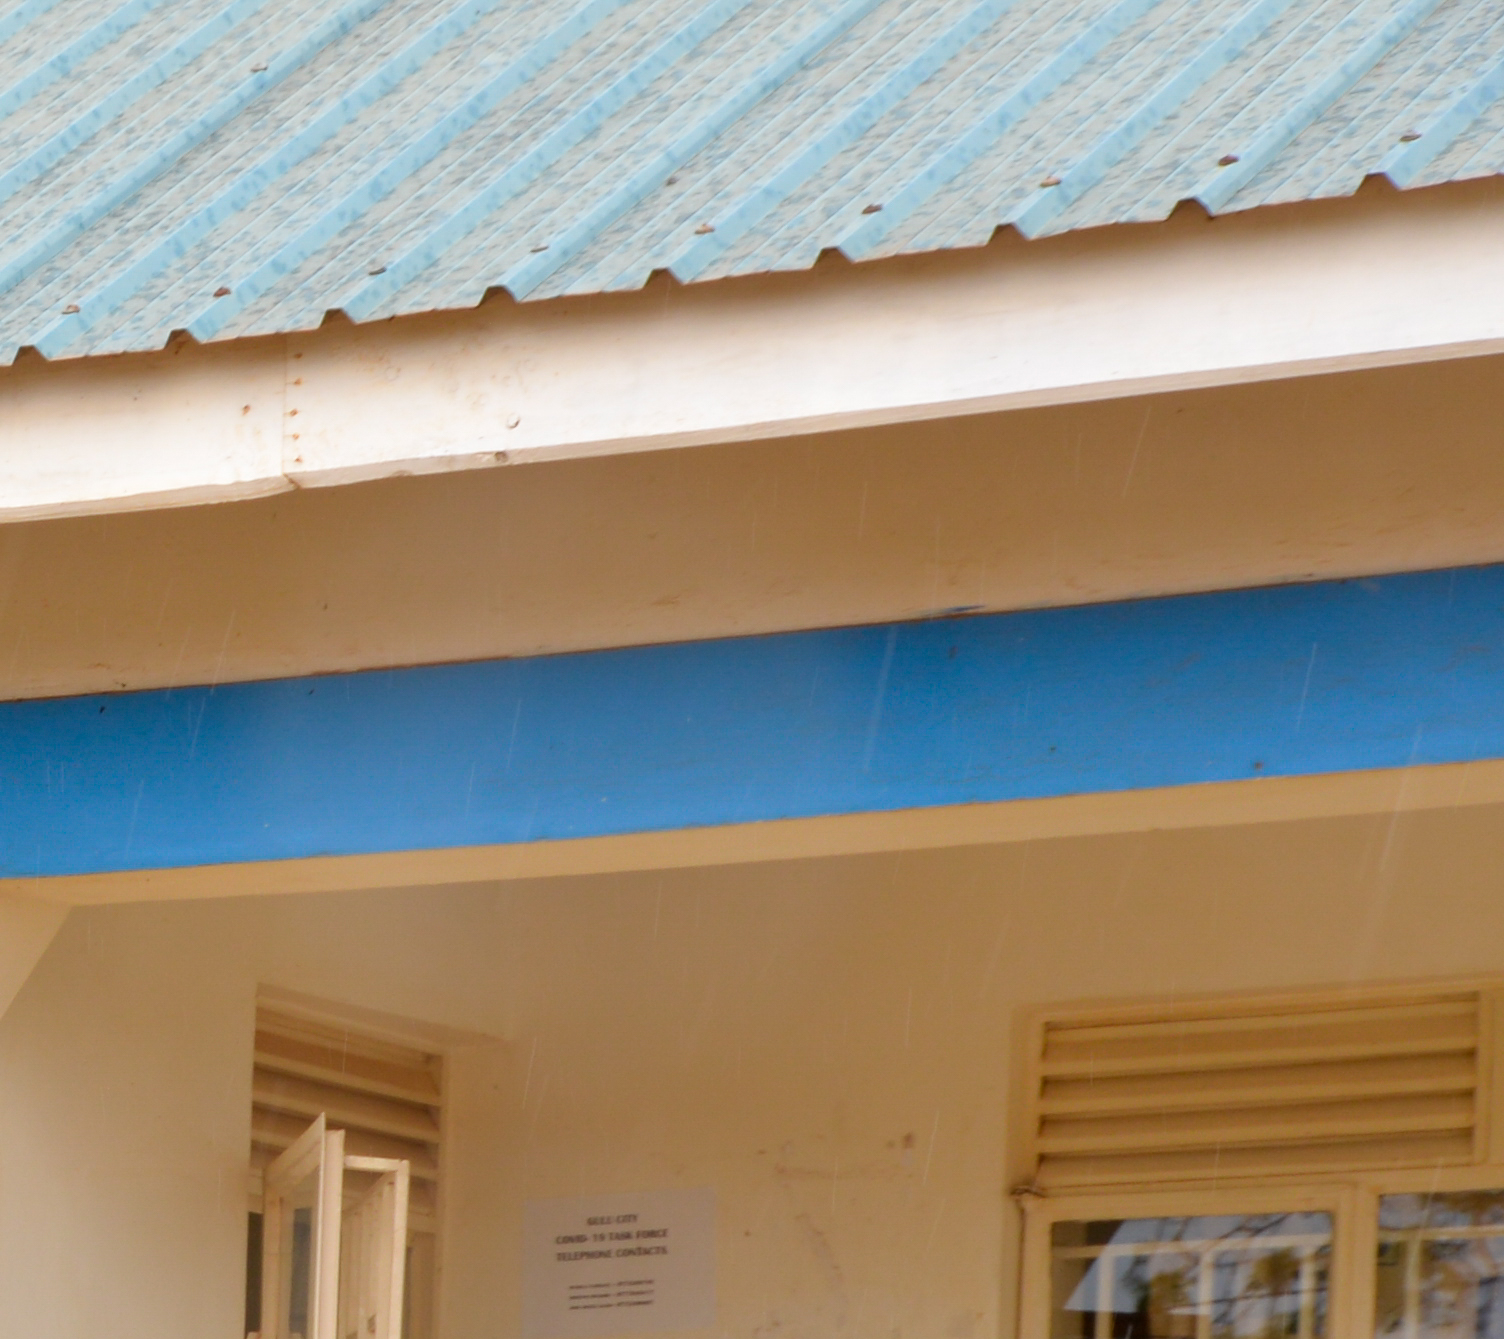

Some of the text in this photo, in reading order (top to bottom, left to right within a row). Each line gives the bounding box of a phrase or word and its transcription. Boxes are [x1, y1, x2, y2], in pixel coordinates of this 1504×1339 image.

[609, 1231, 633, 1241] TASK
[636, 1229, 668, 1239] FORCE
[556, 1246, 668, 1262] TELEPHONE CONTACTS
